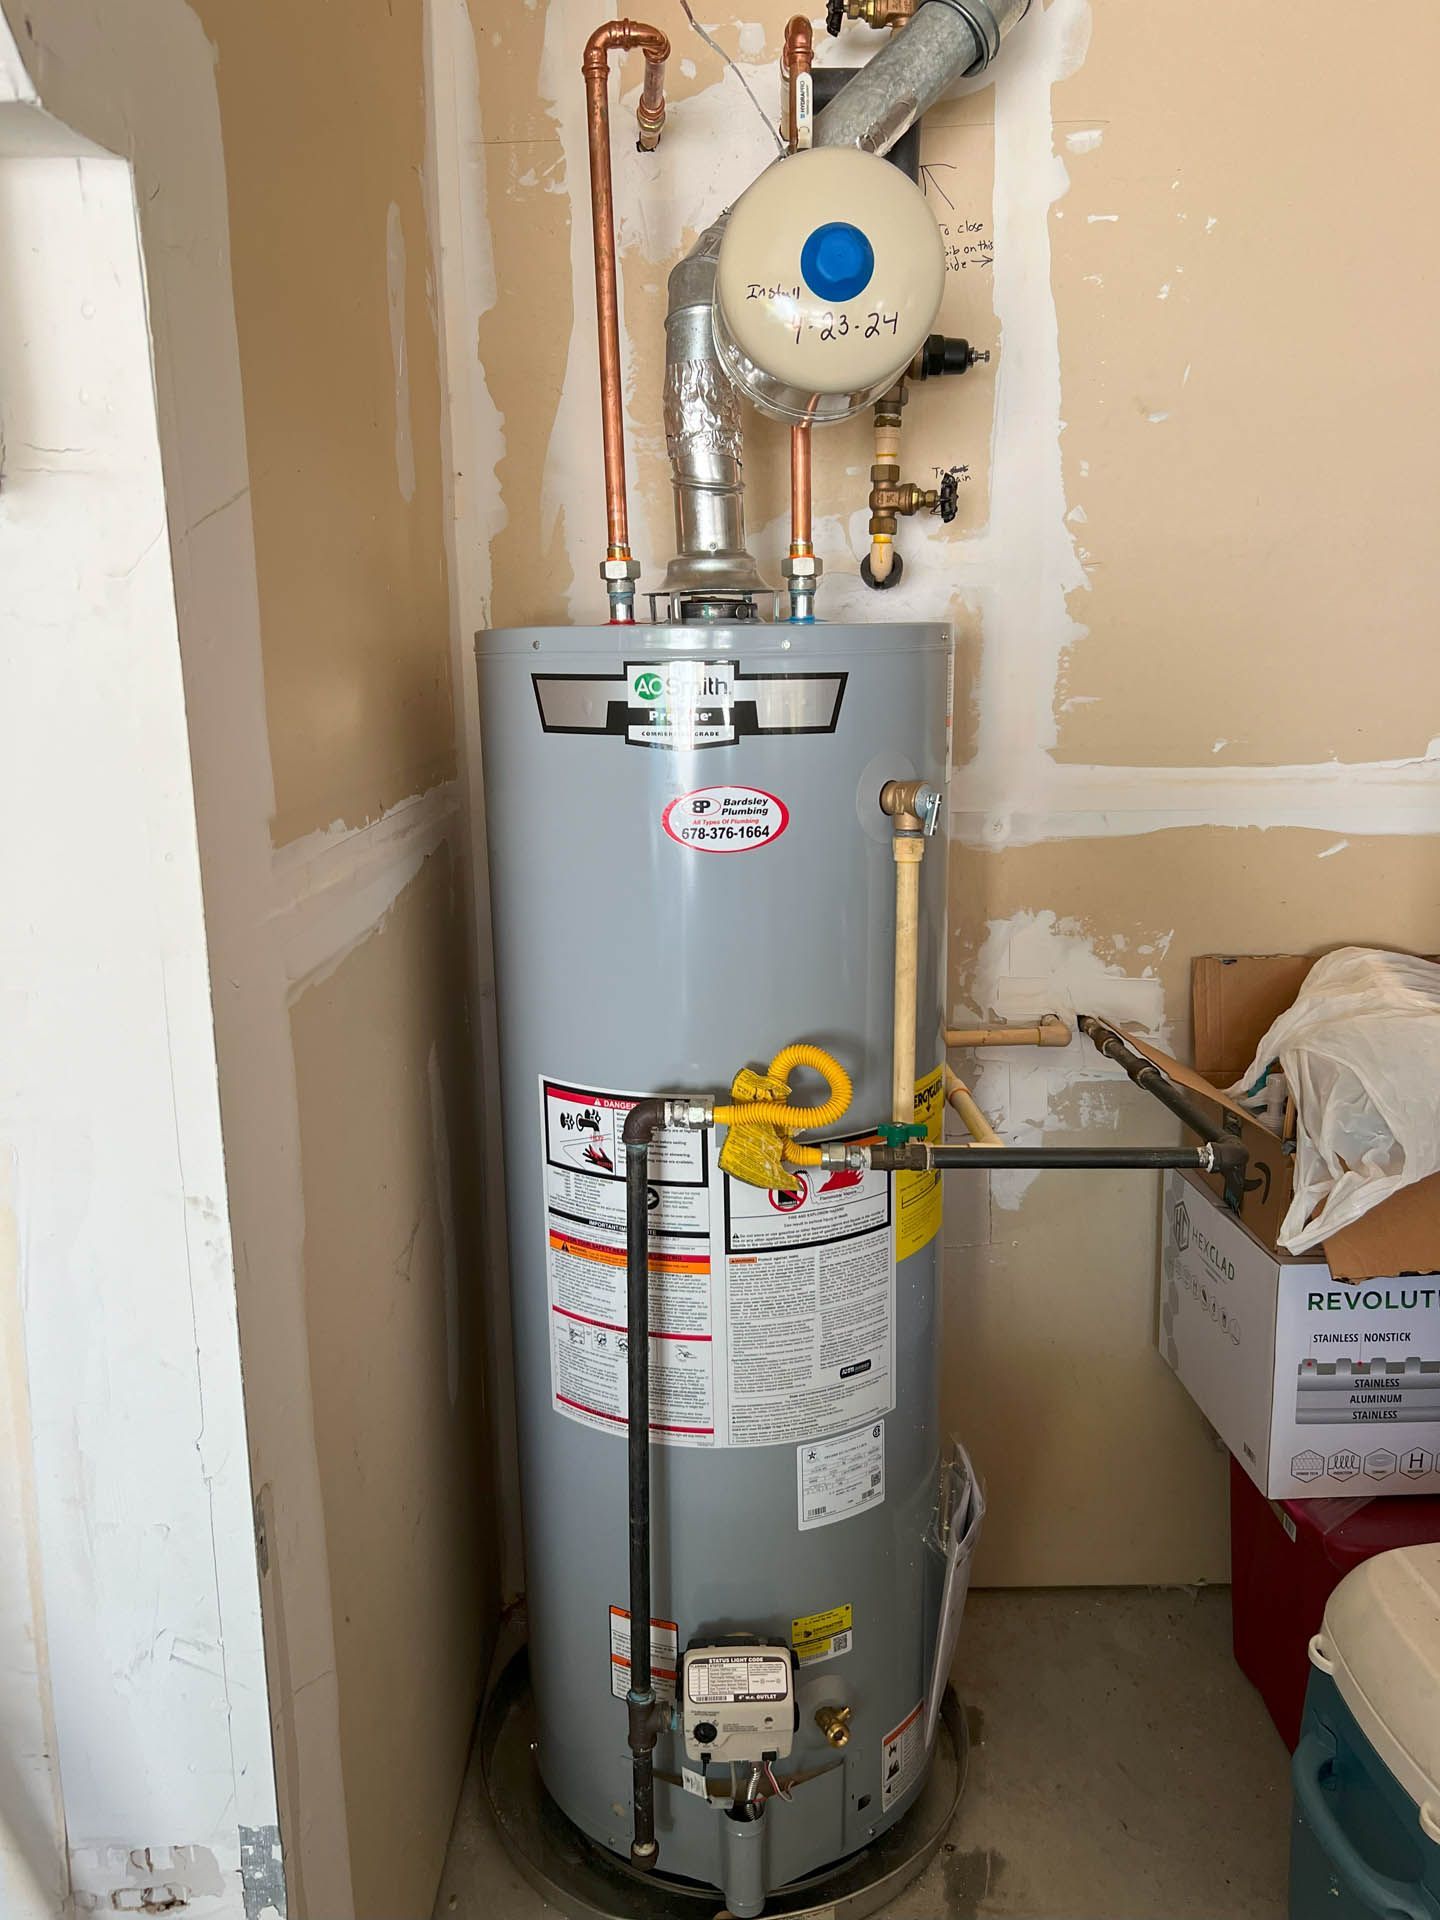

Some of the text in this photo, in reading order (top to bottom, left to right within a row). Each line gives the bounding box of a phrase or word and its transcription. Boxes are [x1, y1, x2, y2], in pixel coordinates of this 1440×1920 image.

[957, 219, 984, 233] close
[977, 239, 994, 251] this
[723, 797, 769, 807] Bardsley
[721, 807, 769, 816] Plumbing
[681, 825, 770, 840] 678-376-1664
[1192, 1225, 1235, 1280] HEXCLAD
[1308, 1290, 1440, 1311] REVOLUT
[1313, 1332, 1411, 1343] STAINLESS NONSTICK
[1354, 1378, 1400, 1388] STAINLESS
[1350, 1394, 1402, 1404] ALUMINUM
[1352, 1410, 1398, 1420] STAINLESS
